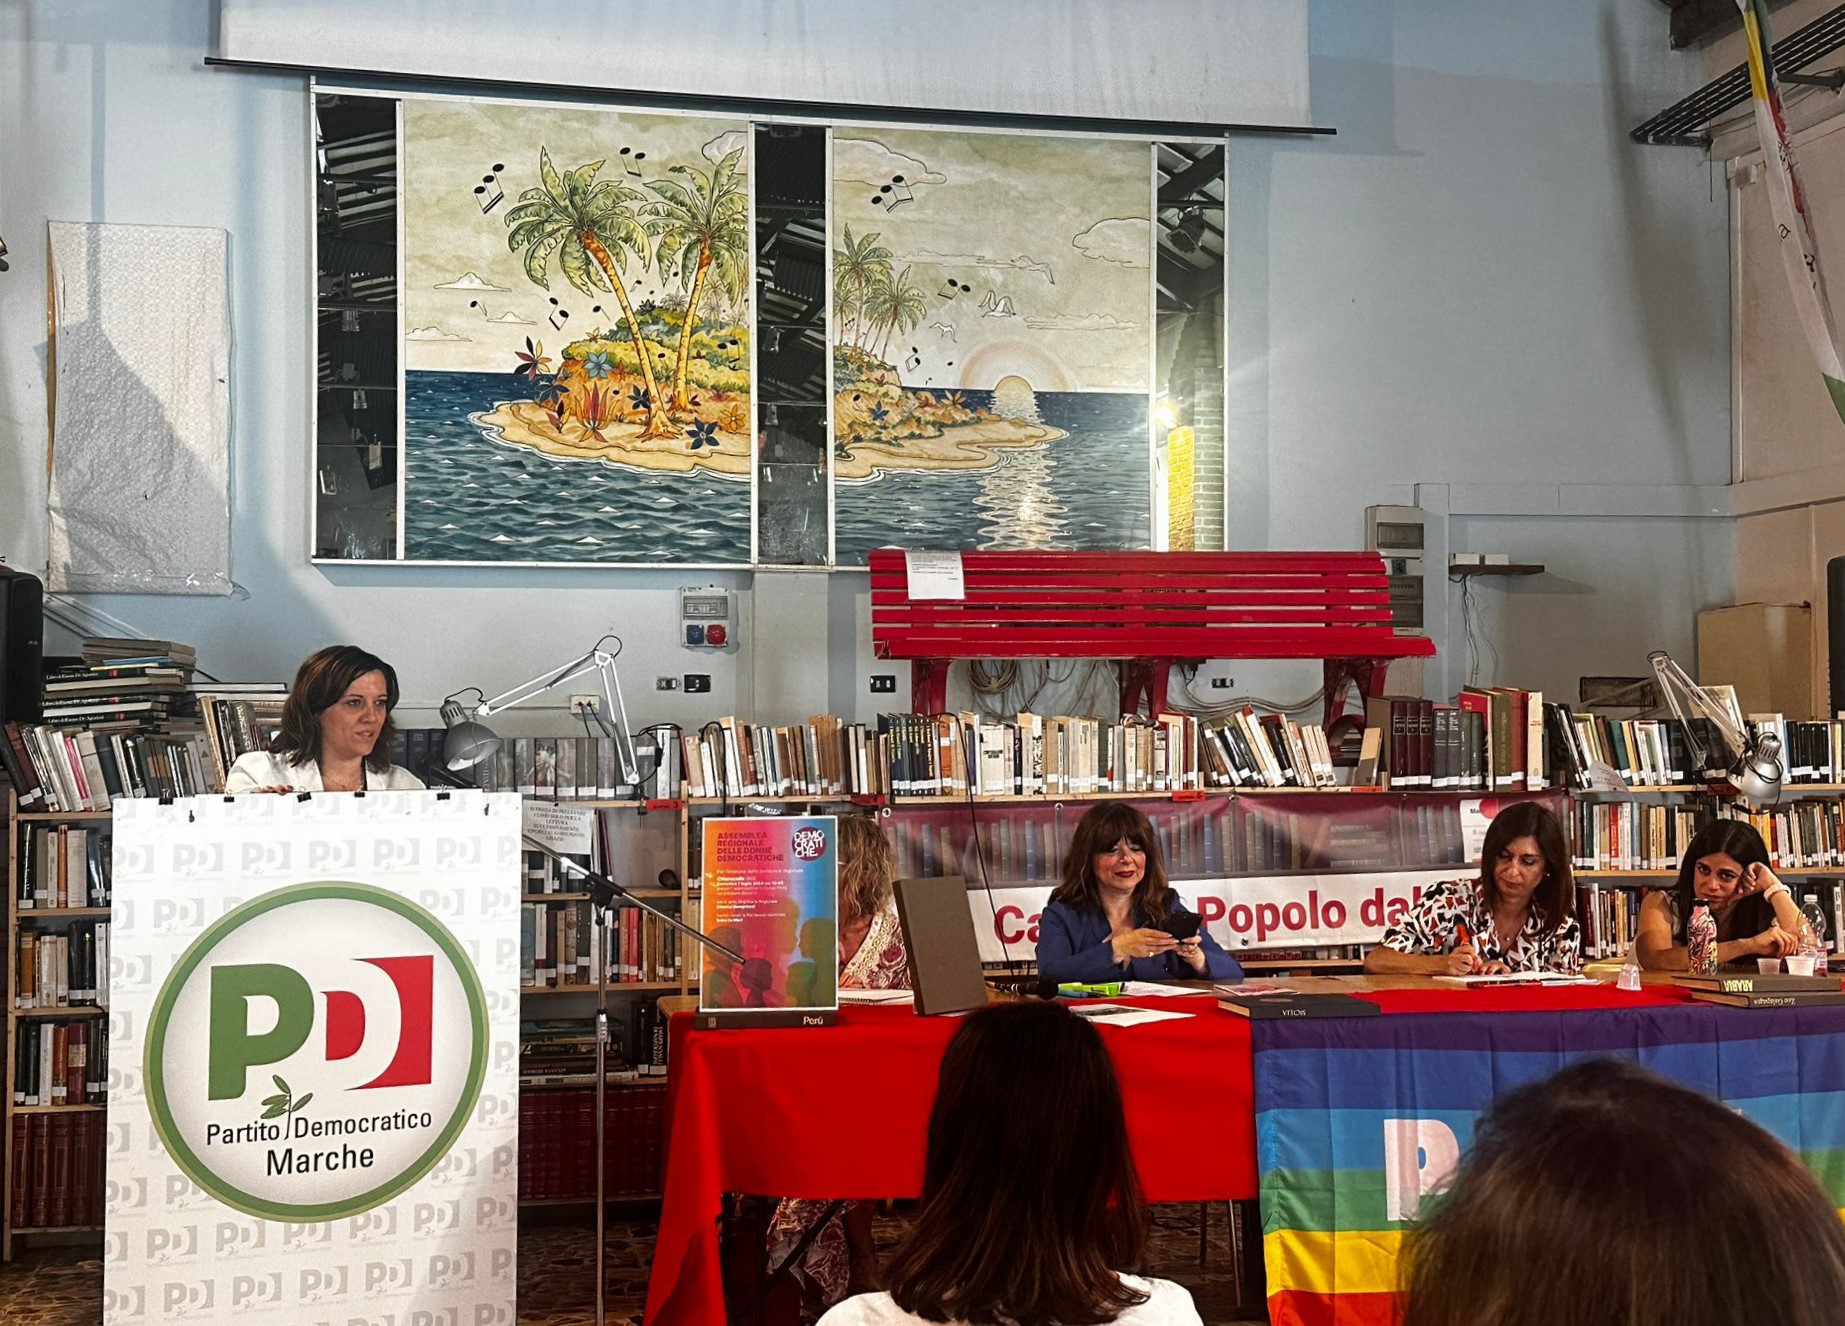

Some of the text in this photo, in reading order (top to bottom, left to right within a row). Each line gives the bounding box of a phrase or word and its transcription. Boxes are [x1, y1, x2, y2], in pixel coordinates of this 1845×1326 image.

[437, 836, 480, 864] PD
[744, 846, 772, 854] DONNE
[794, 830, 824, 840] DEMO
[794, 839, 824, 849] CRATI
[173, 842, 223, 872] PD
[242, 841, 291, 870] PD
[309, 840, 356, 868] PD
[374, 838, 419, 866] PD
[717, 854, 784, 862] DEMOCRATICHE
[795, 849, 818, 857] CHE
[154, 898, 204, 927] PD
[420, 889, 464, 915] PD
[994, 905, 1040, 944] Ca
[1197, 889, 1347, 942] Popolo
[1724, 980, 1753, 992] ARABIA
[209, 953, 434, 1101] PD
[206, 1110, 432, 1146] Partito Democratico
[266, 1144, 375, 1176] Marche
[350, 1207, 396, 1238] PD
[414, 1201, 459, 1231] PD
[147, 1226, 197, 1258] PD
[216, 1221, 265, 1252] PD
[300, 1266, 348, 1297] PD
[366, 1259, 412, 1291] PD
[430, 1252, 475, 1283] PD
[164, 1280, 214, 1311] PD
[233, 1273, 282, 1305] PD
